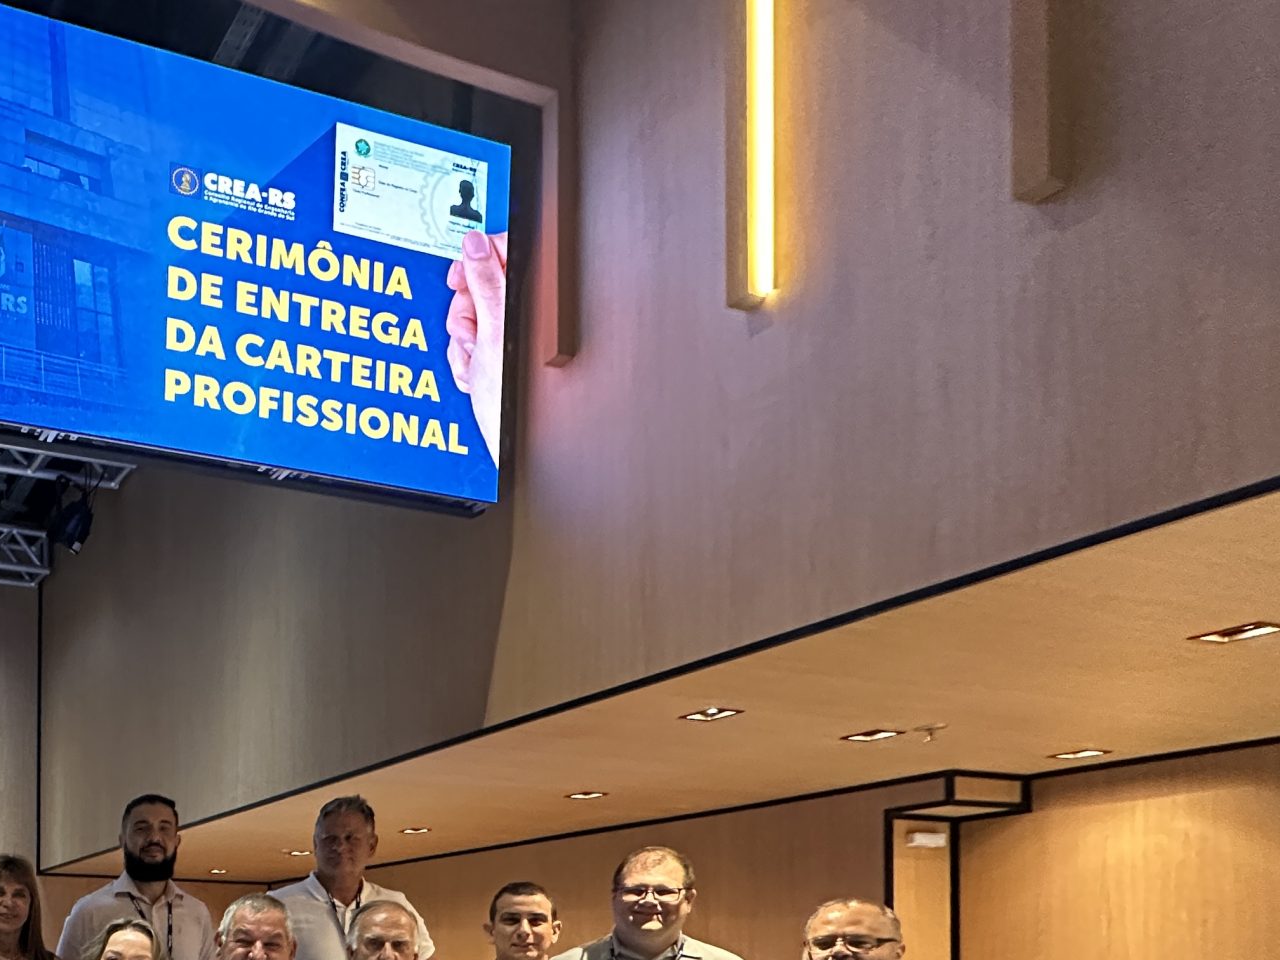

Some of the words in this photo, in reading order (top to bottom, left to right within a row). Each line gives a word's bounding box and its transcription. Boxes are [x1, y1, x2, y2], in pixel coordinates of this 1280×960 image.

[203, 172, 296, 210] CREA-RS
[167, 215, 413, 300] CERIMÔNIA
[167, 265, 223, 309] DE
[236, 280, 428, 352] ENTREGA
[165, 317, 226, 361] DA
[235, 333, 441, 403] CARTEIRA
[164, 368, 469, 456] PROFISSIONAL
